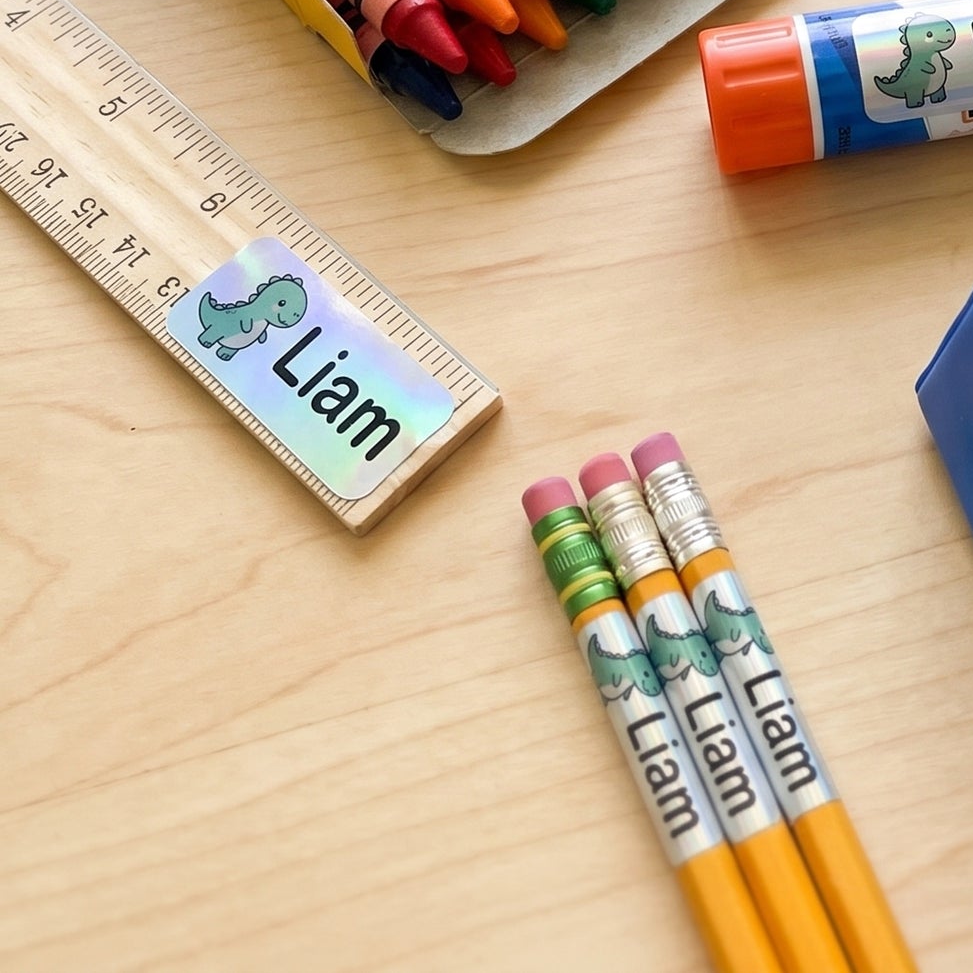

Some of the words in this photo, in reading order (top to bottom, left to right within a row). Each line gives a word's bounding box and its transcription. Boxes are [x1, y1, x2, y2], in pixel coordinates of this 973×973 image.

[4, 9, 31, 28] 4
[99, 95, 127, 116] 5
[200, 192, 227, 212] 6
[30, 158, 69, 189] 16
[71, 197, 109, 229] 15
[112, 234, 151, 268] 14
[157, 276, 191, 308] 13
[272, 326, 402, 463] Liam
[626, 711, 701, 839] Liam
[684, 691, 757, 819] Liam
[744, 668, 818, 793] Liam
